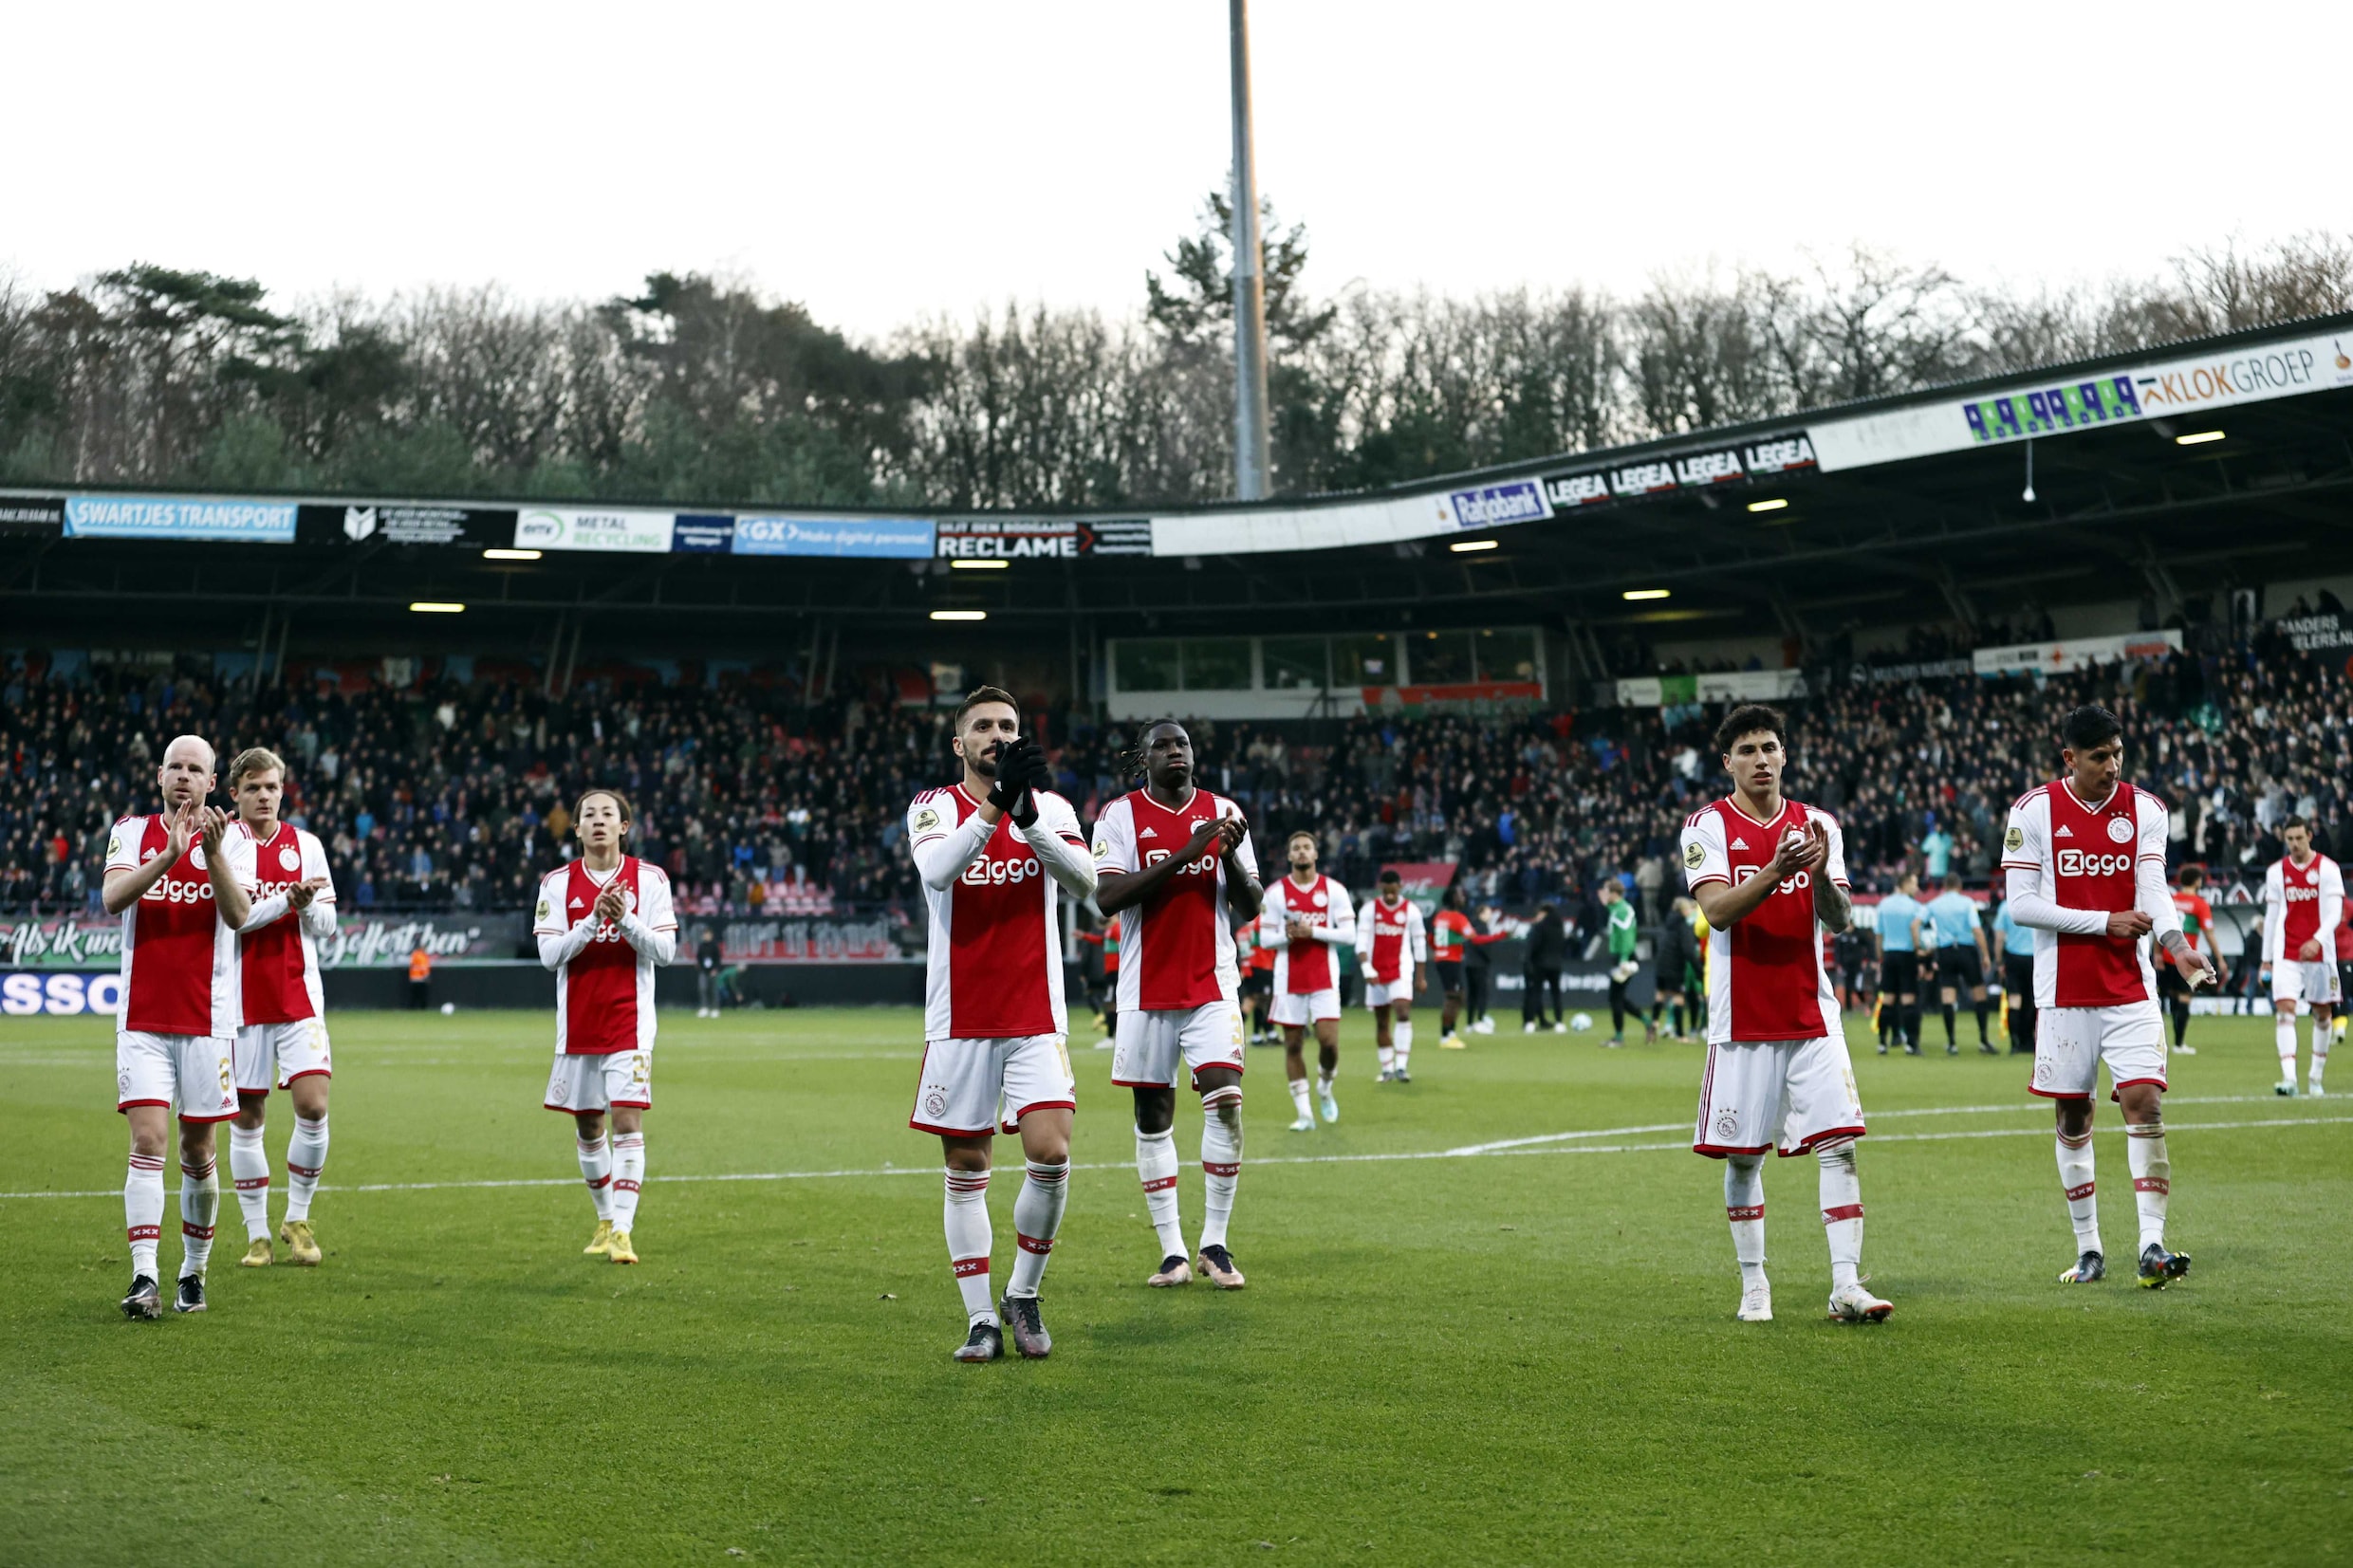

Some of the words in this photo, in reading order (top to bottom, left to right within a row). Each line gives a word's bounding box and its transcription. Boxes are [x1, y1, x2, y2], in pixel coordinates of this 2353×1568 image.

[2160, 349, 2315, 405] KLOKGROEP
[1676, 451, 1744, 486] LEGEA
[1745, 438, 1814, 472] LEGEA
[1547, 474, 1609, 505] LEGEA
[1611, 463, 1676, 493] LEGEA
[77, 501, 176, 526] SWARTJES
[177, 504, 295, 529] TRANSPORT
[1454, 485, 1541, 524] Rabobank
[575, 516, 628, 530] METAL
[572, 531, 662, 547] RECYCLING
[937, 536, 1079, 558] RECLAME
